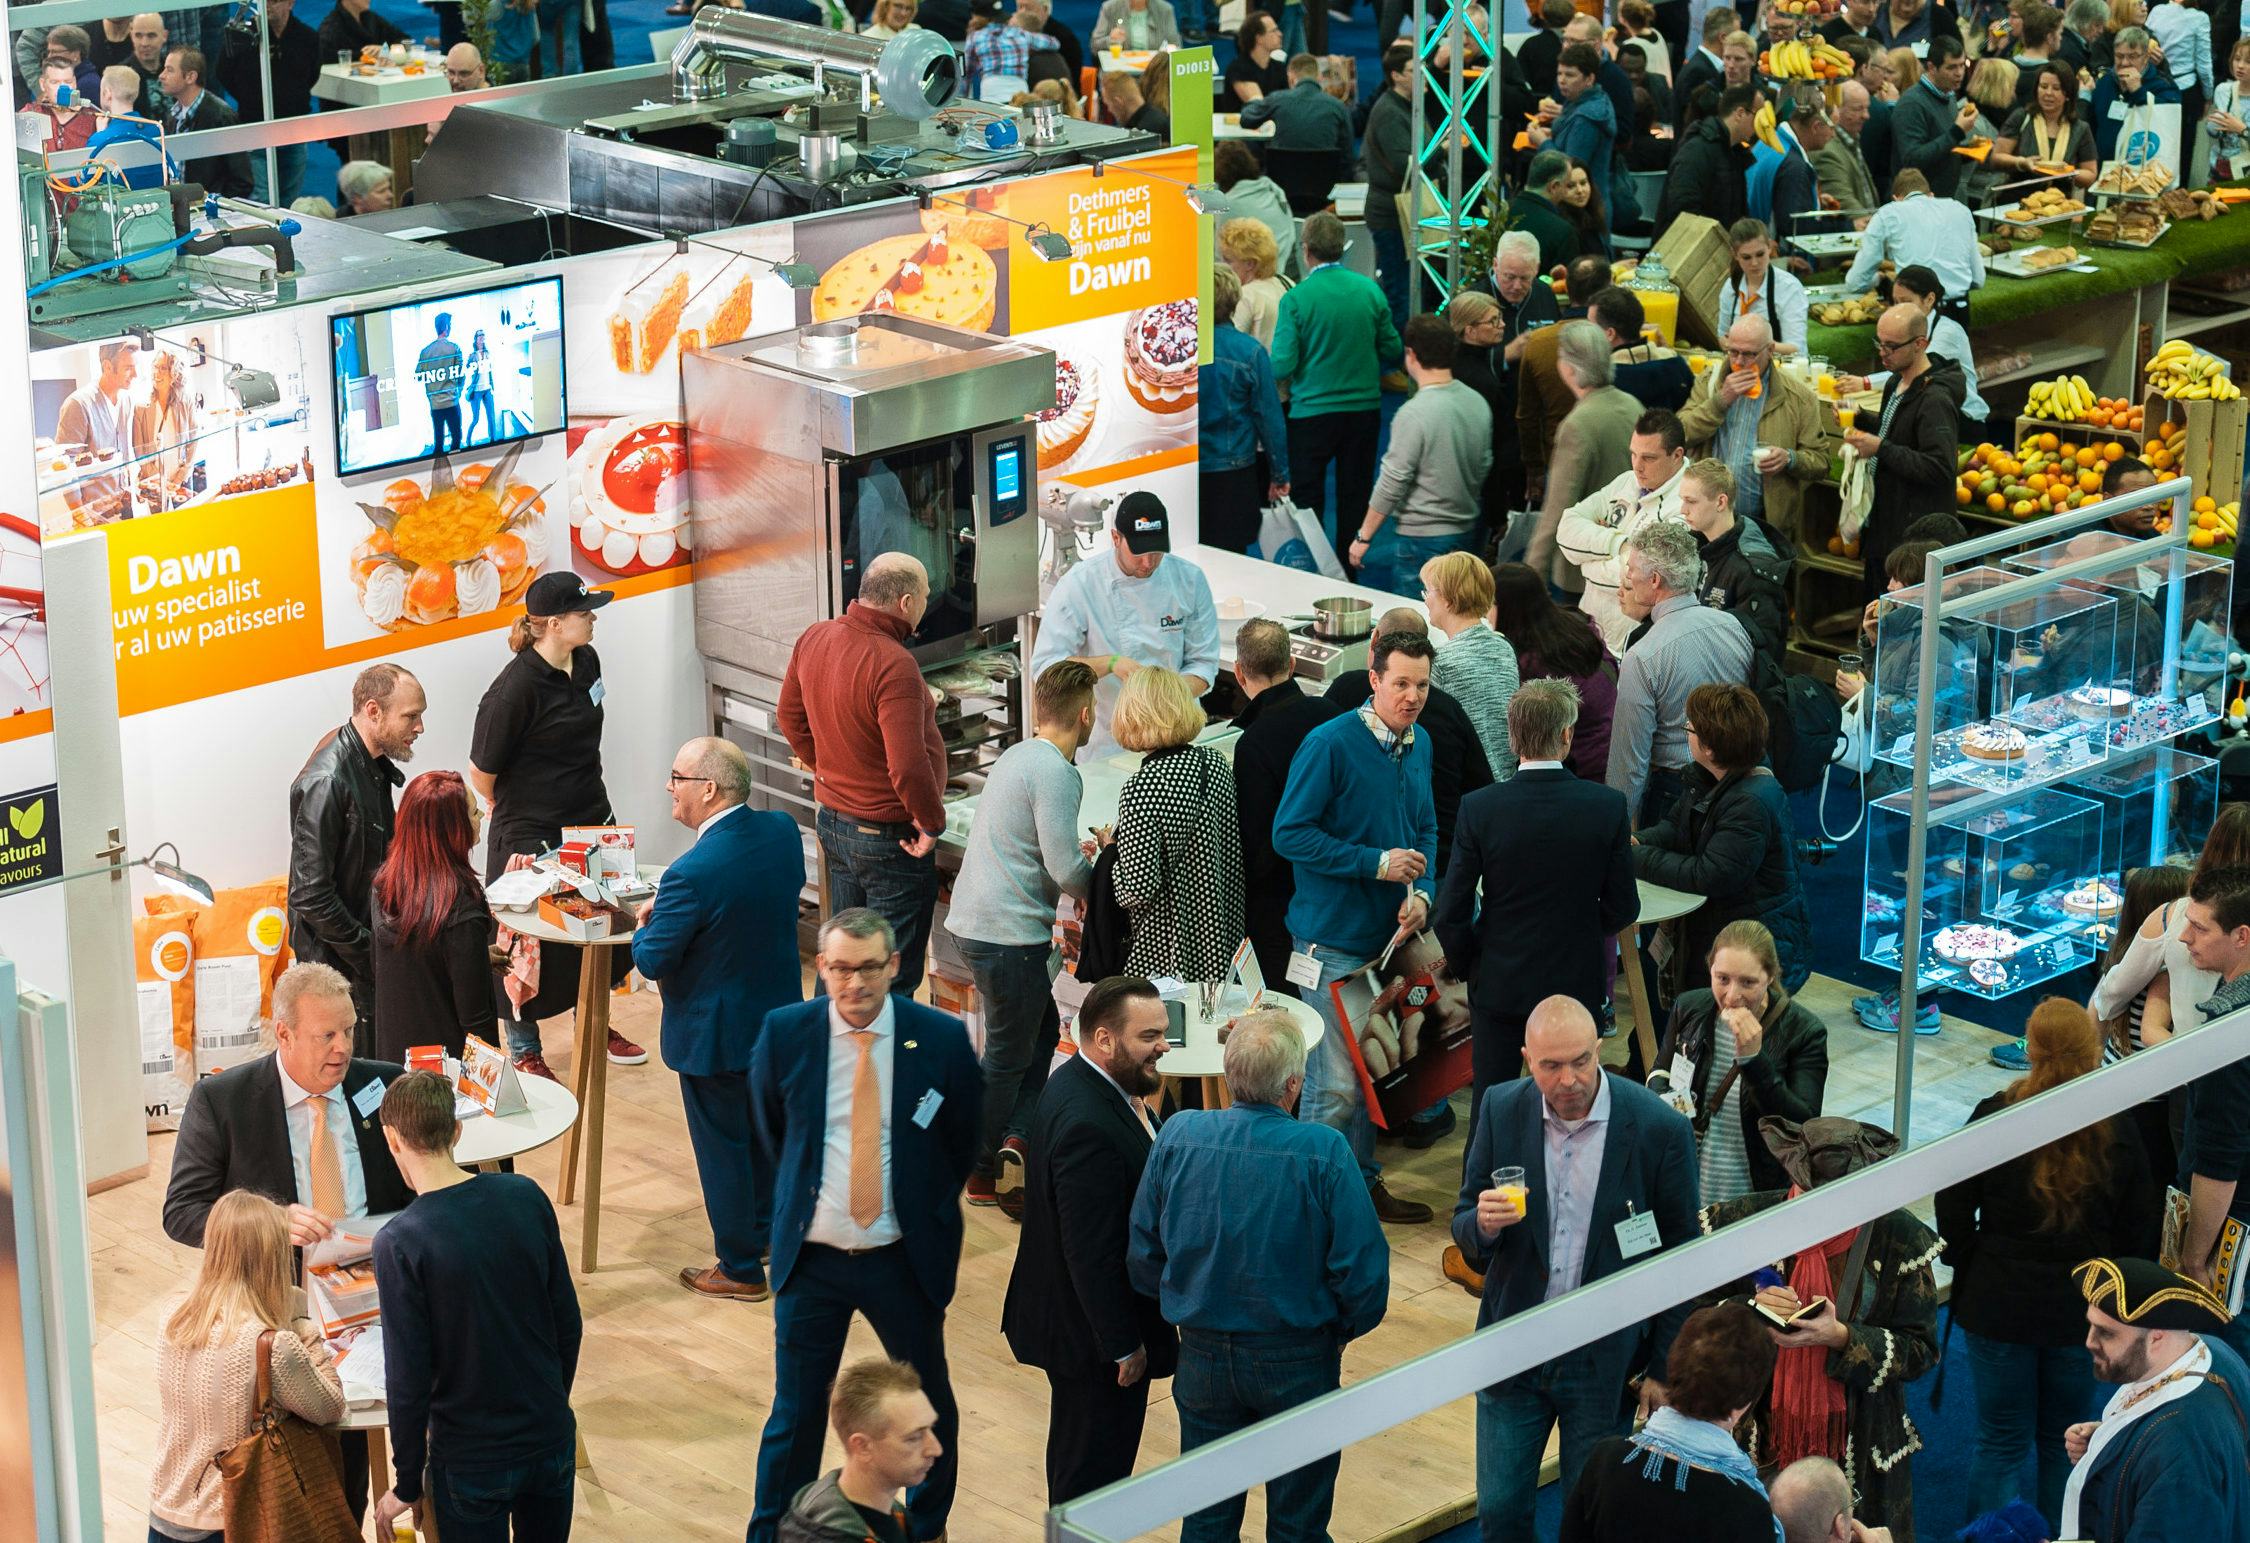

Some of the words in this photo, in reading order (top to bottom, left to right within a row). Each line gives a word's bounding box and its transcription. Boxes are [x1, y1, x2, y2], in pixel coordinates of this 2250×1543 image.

[1176, 61, 1210, 76] D1013
[1069, 184, 1150, 215] Dethmers
[1068, 217, 1083, 240] &
[1087, 202, 1151, 237] Fruibel
[1070, 240, 1092, 261] zijn
[1095, 229, 1132, 253] vanaf
[1134, 230, 1151, 245] nu
[1069, 256, 1151, 296] Dawn
[1135, 519, 1162, 532] Dawn
[128, 545, 240, 595] Dawn
[113, 605, 149, 629] uw
[156, 577, 261, 624] specialist
[130, 629, 150, 657] al
[156, 627, 192, 650] uw
[198, 598, 305, 647] patisserie
